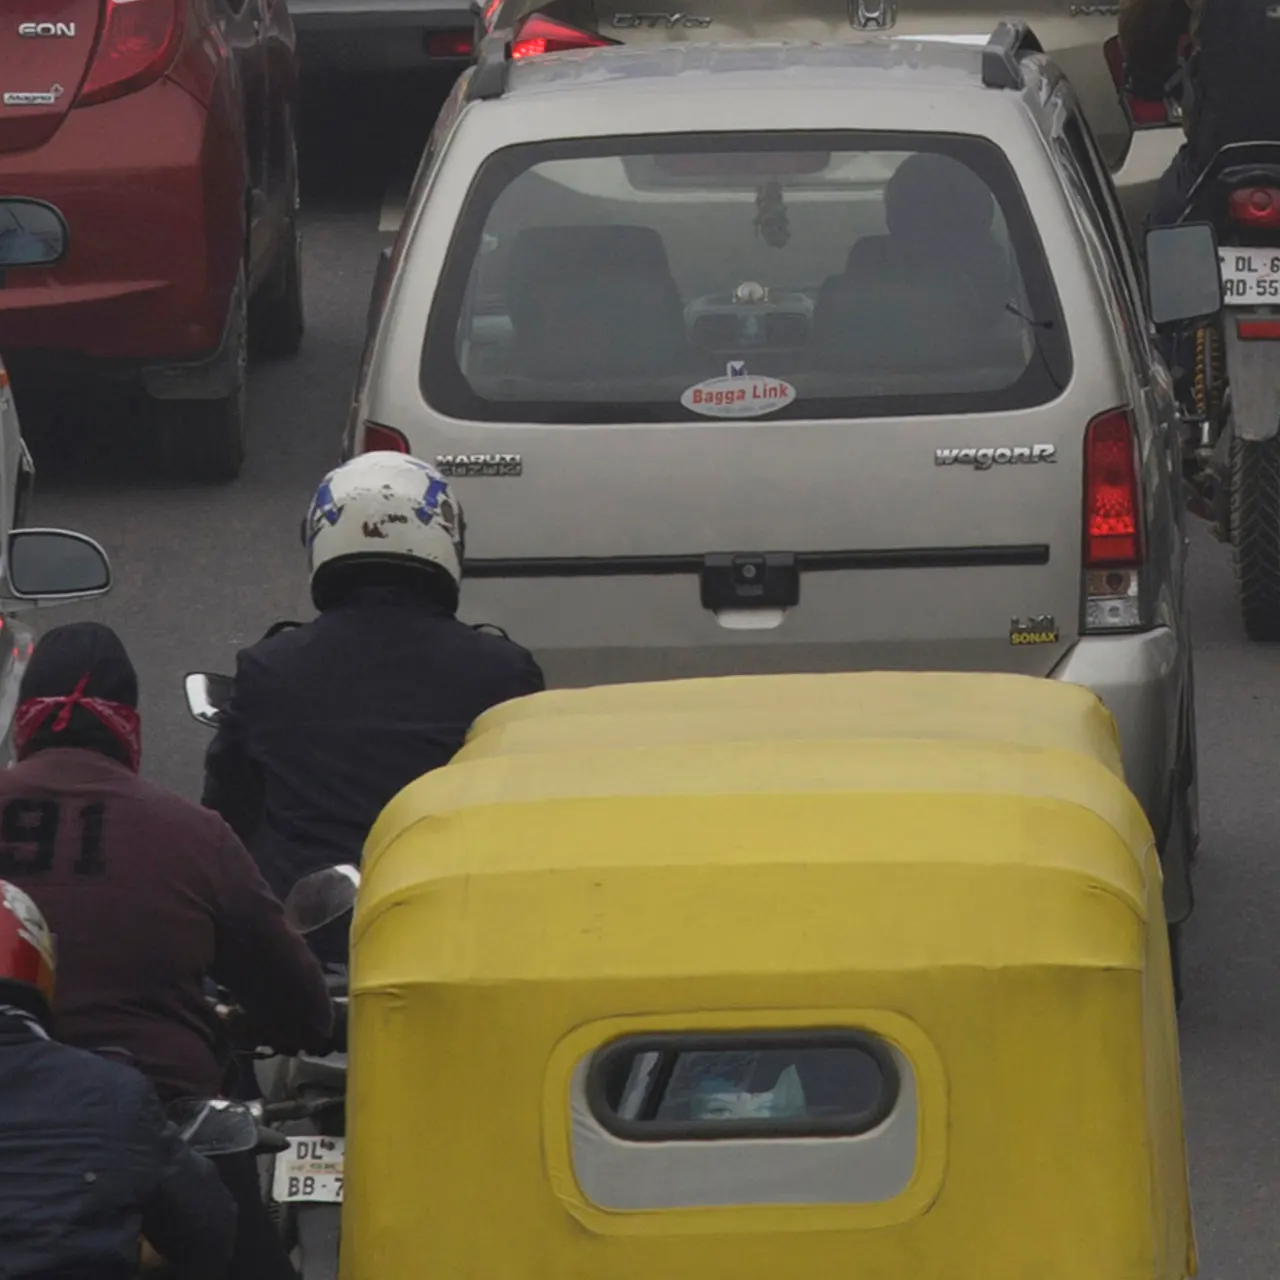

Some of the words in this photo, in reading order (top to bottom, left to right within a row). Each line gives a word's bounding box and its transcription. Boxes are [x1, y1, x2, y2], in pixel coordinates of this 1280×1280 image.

[18, 21, 76, 38] EON
[691, 385, 746, 407] Bagga
[751, 380, 790, 401] Link
[436, 454, 522, 466] MARUTI
[1012, 631, 1056, 645] SONAX
[287, 1176, 315, 1198] BB
